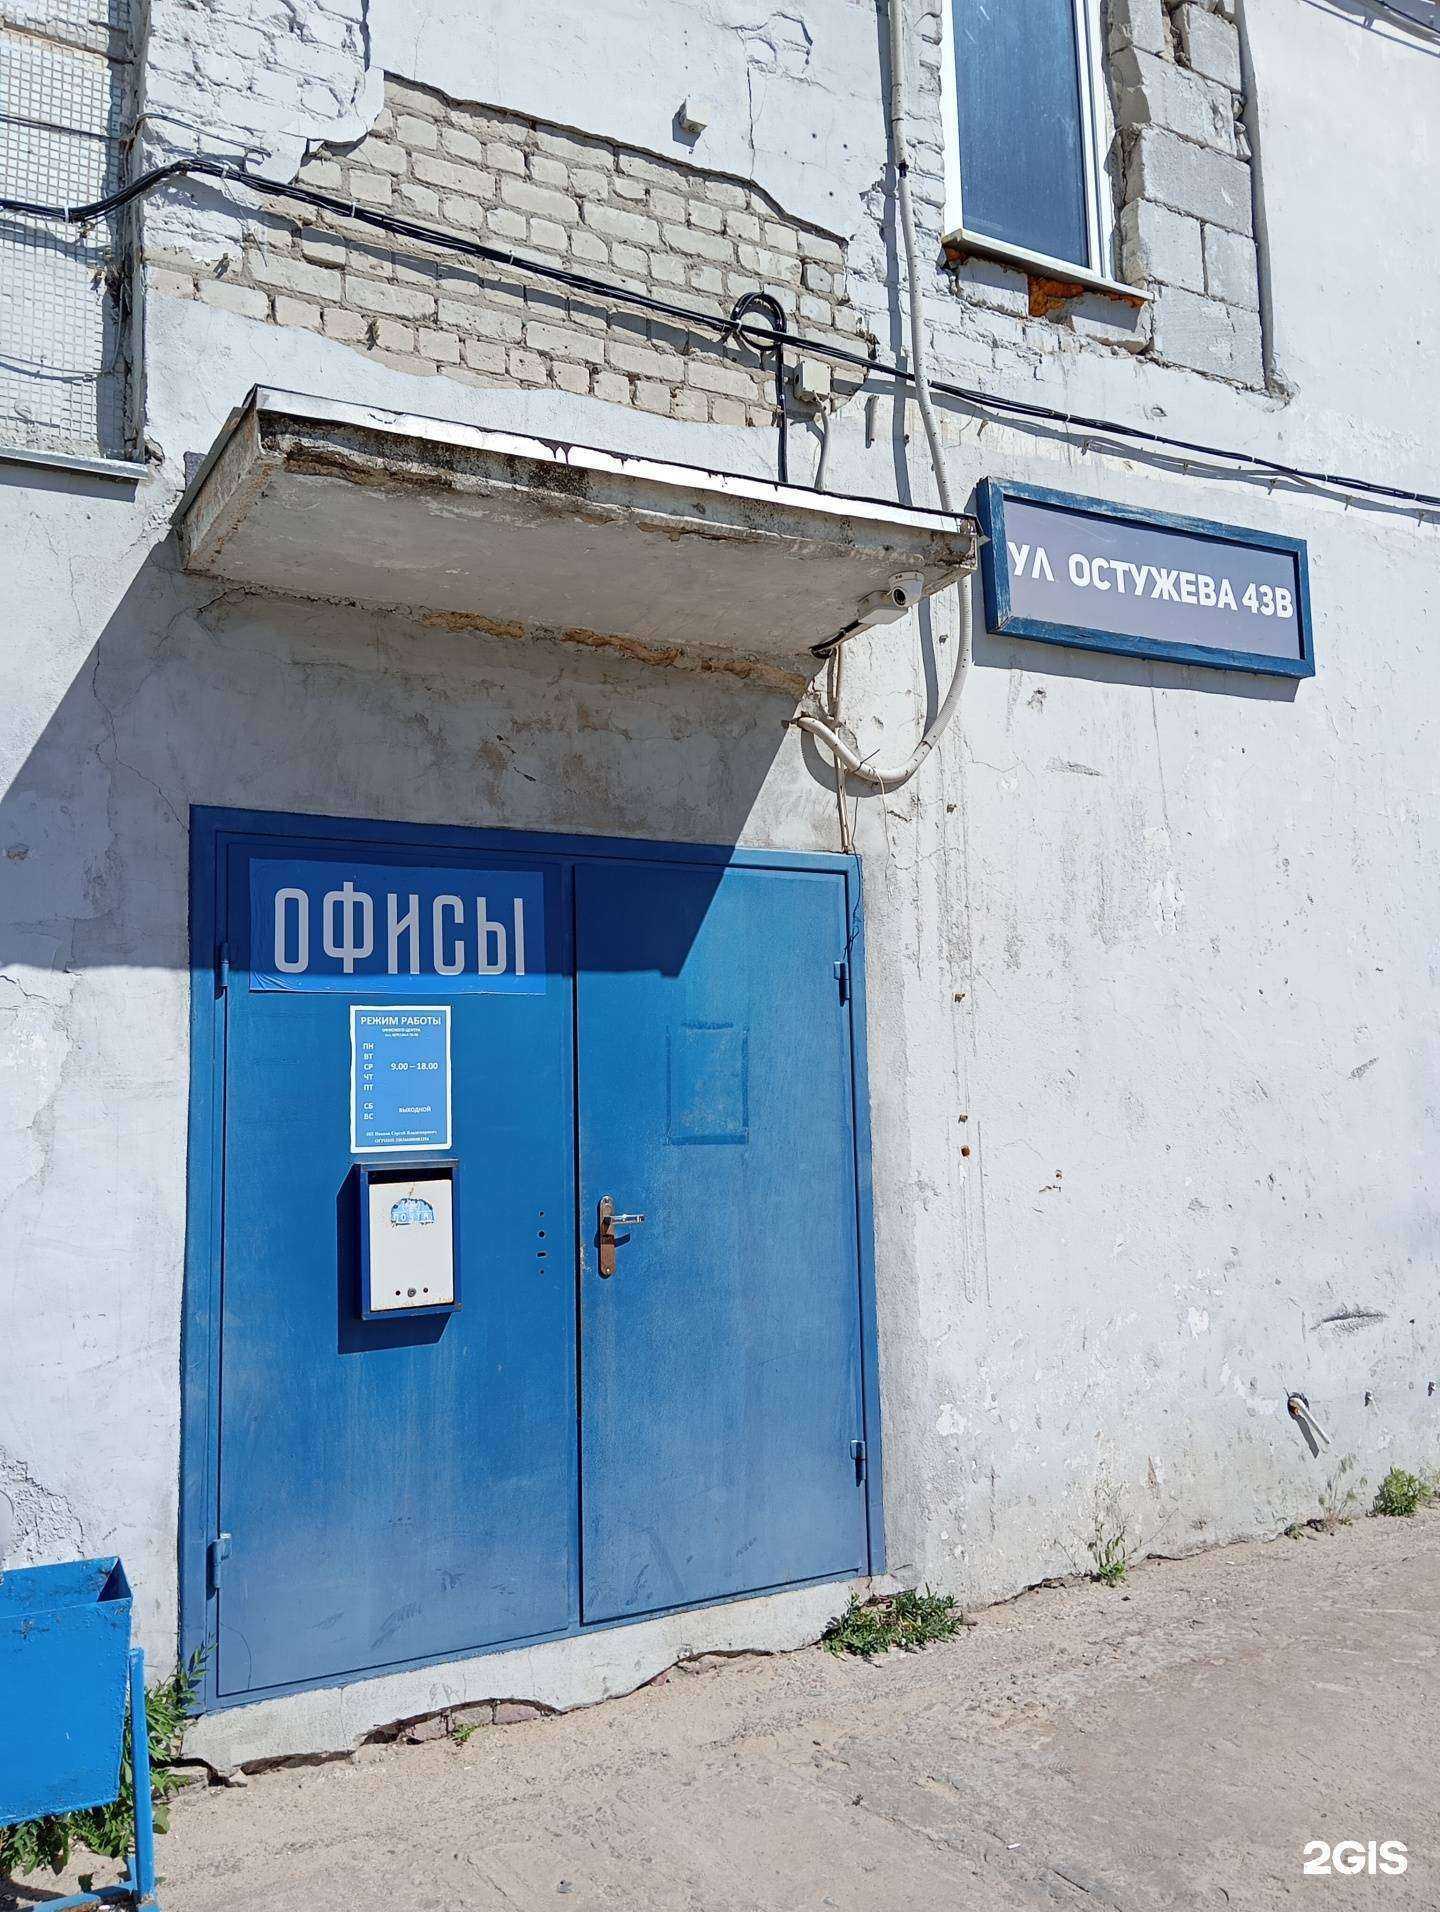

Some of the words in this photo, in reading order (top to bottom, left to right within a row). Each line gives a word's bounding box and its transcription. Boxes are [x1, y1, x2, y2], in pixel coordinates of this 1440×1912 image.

[1008, 541, 1055, 582] УЛ
[1068, 553, 1238, 611] ОСТУЖЕВА
[1242, 582, 1295, 619] 43В
[274, 881, 525, 976] ОФИСЫ
[361, 1016, 399, 1025] РЕЖИМ
[401, 1016, 442, 1025] РАБОТЫ
[390, 1062, 409, 1071] 9.00
[416, 1062, 439, 1070] 18.00
